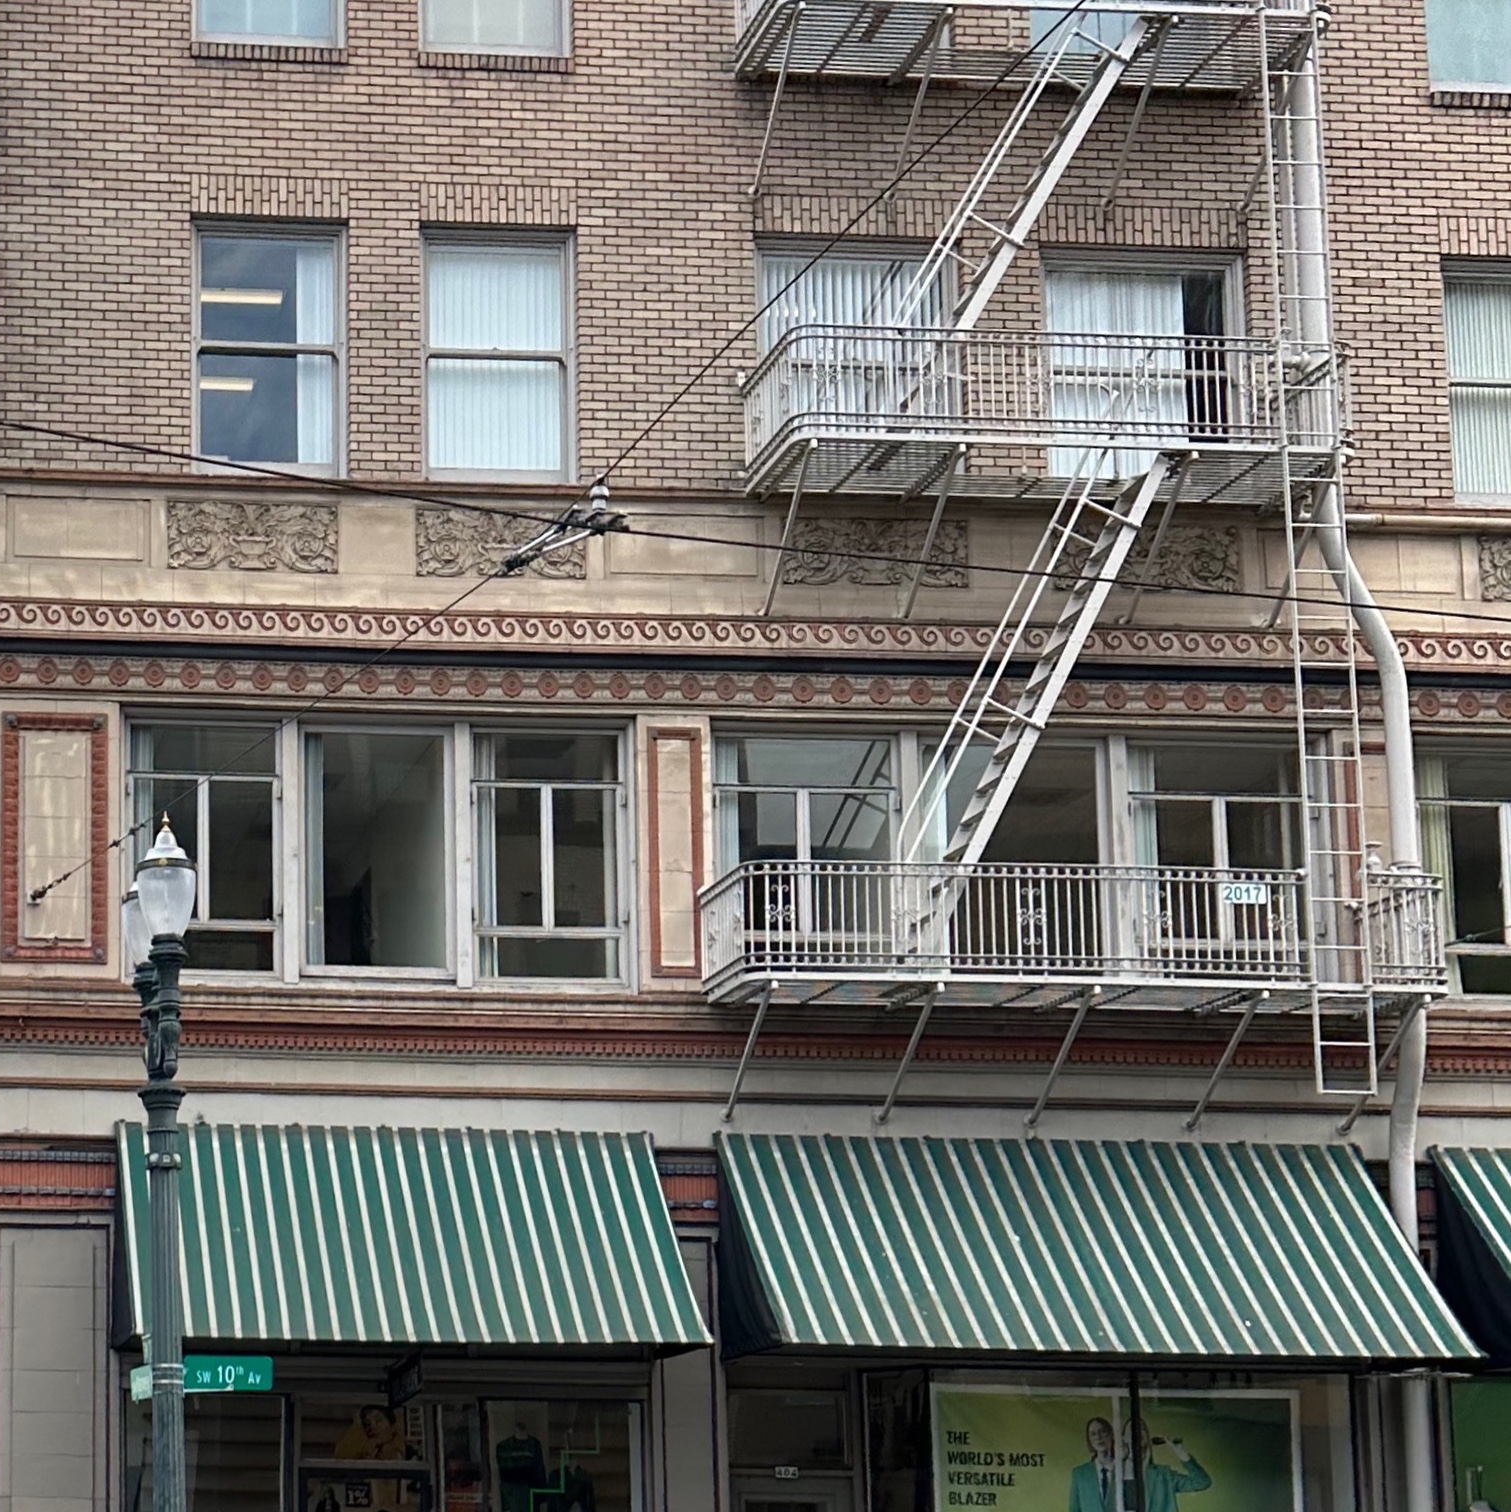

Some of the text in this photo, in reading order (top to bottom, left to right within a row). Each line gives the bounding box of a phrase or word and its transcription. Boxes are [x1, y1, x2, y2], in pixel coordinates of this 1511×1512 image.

[1223, 885, 1262, 902] 2017
[196, 1365, 262, 1384] SW 10th Av
[946, 1431, 970, 1445] THE
[947, 1451, 1046, 1467] WORLD'S MOST
[948, 1471, 1015, 1487] VERSATILE
[948, 1491, 997, 1506] BLAZER
